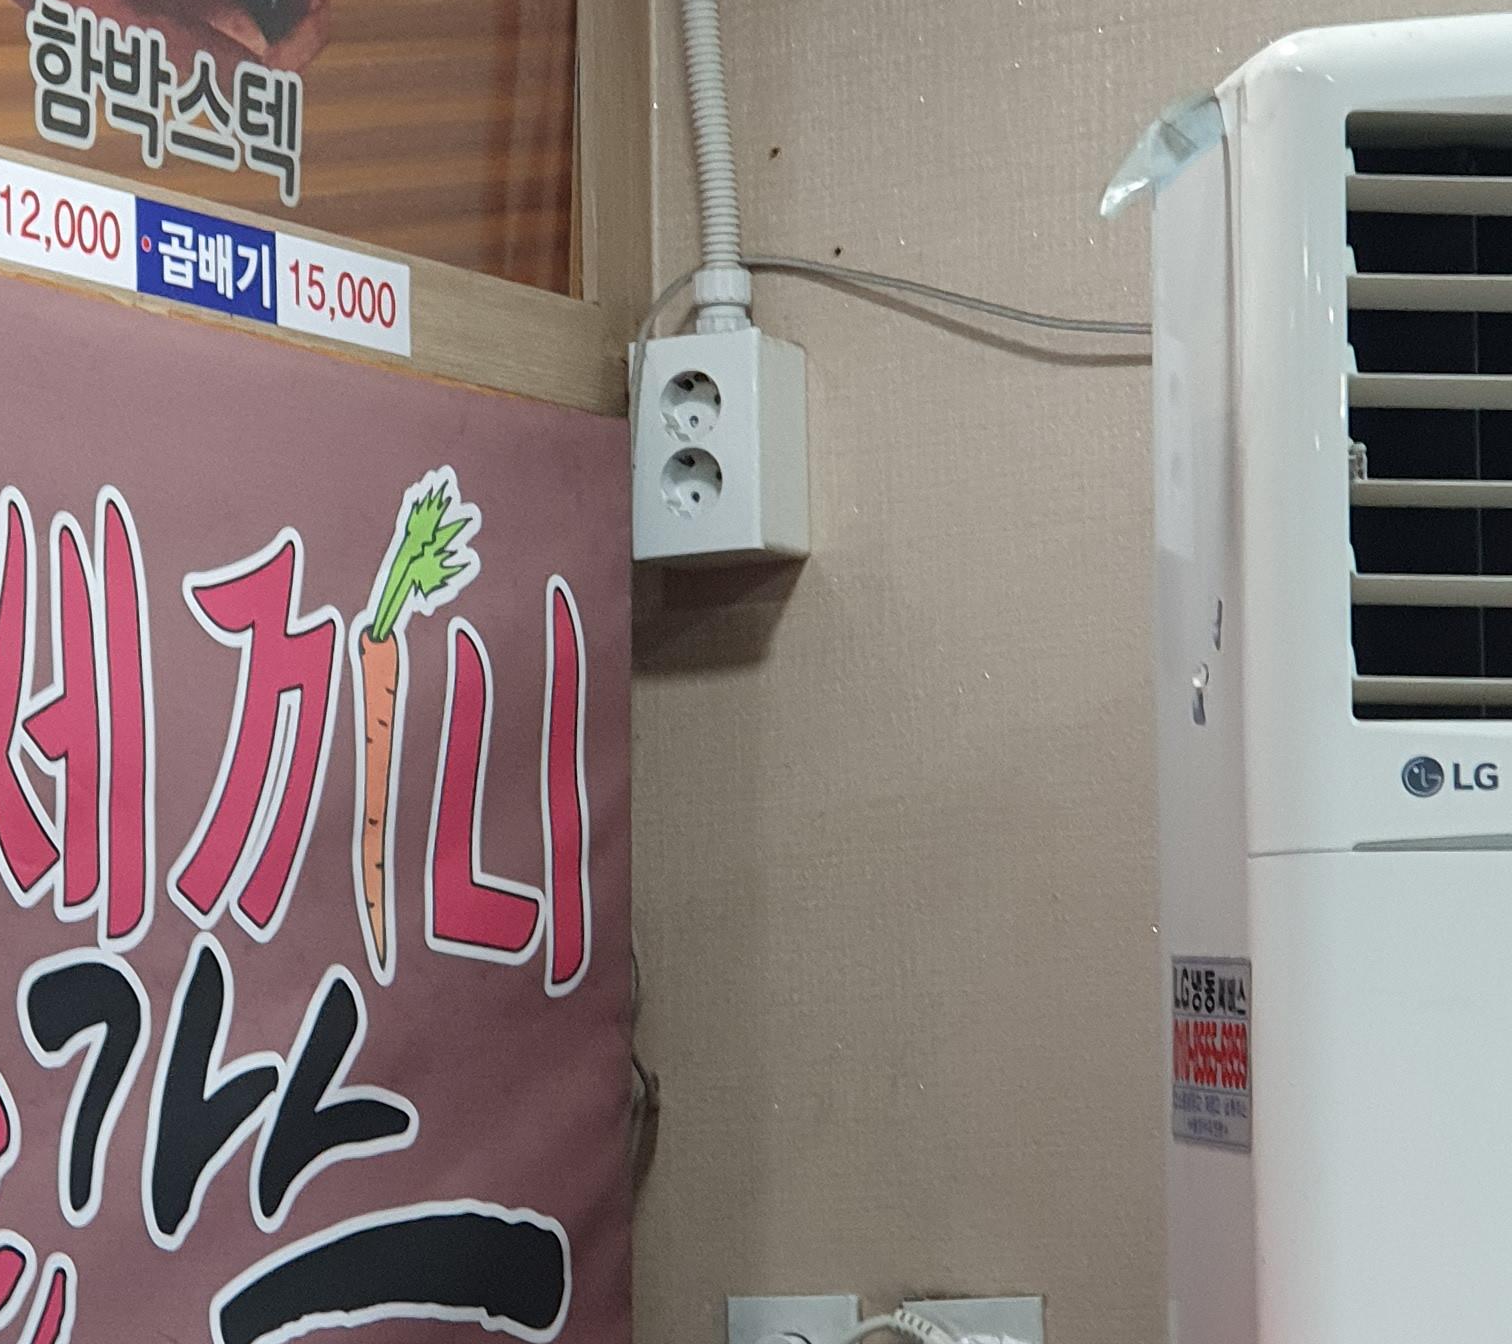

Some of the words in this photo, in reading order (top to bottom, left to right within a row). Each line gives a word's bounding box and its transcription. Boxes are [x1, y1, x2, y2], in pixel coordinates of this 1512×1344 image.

[157, 218, 272, 309] 곱배기
[288, 258, 397, 330] 15,000
[1453, 762, 1500, 792] LG
